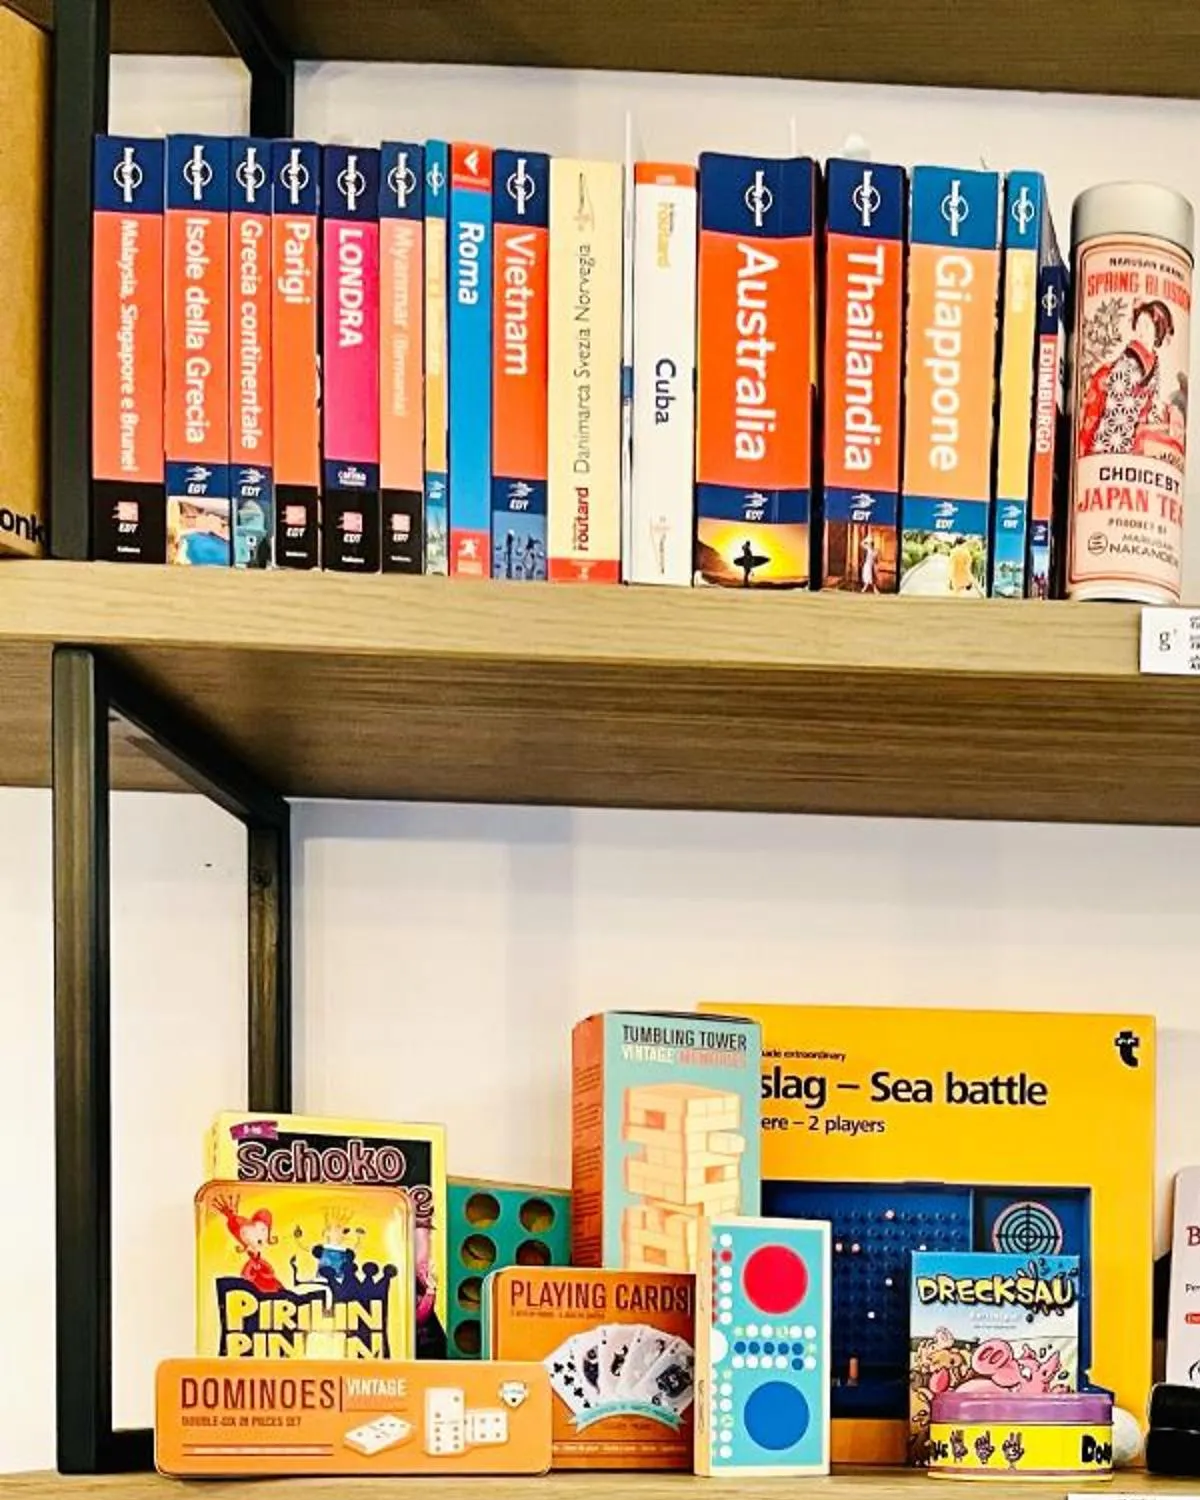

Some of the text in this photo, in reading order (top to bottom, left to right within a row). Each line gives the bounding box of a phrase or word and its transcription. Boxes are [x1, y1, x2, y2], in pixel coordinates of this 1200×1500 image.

[277, 221, 312, 304] Parigi
[338, 227, 364, 348] LONDRA
[457, 221, 485, 305] Roma
[573, 243, 597, 322] Norvegia
[184, 217, 212, 444] Isole della Grecia
[240, 219, 263, 449] Grecia continentale
[503, 232, 538, 377] Vietnam
[573, 328, 591, 378] Svezia
[735, 242, 780, 462] Australia
[843, 243, 885, 472] Thailandia
[923, 254, 974, 472] Giappone
[655, 357, 677, 425] Cuba
[573, 384, 591, 474] Danimarca
[1075, 486, 1149, 513] JAPAN
[621, 1044, 674, 1063] VINTAGE
[622, 1025, 748, 1052] TUMBLING TOWER
[870, 1070, 933, 1104] Sea
[945, 1071, 1048, 1107] battle
[808, 1115, 820, 1131] 2
[825, 1114, 886, 1138] players
[236, 1139, 407, 1185] Schoko
[510, 1279, 689, 1313] PLAYING CARDS
[916, 1274, 1074, 1308] DRECKSAU
[1185, 1283, 1200, 1294] Per
[181, 1377, 335, 1410] DOMINOES
[345, 1375, 408, 1397] VINTAGE
